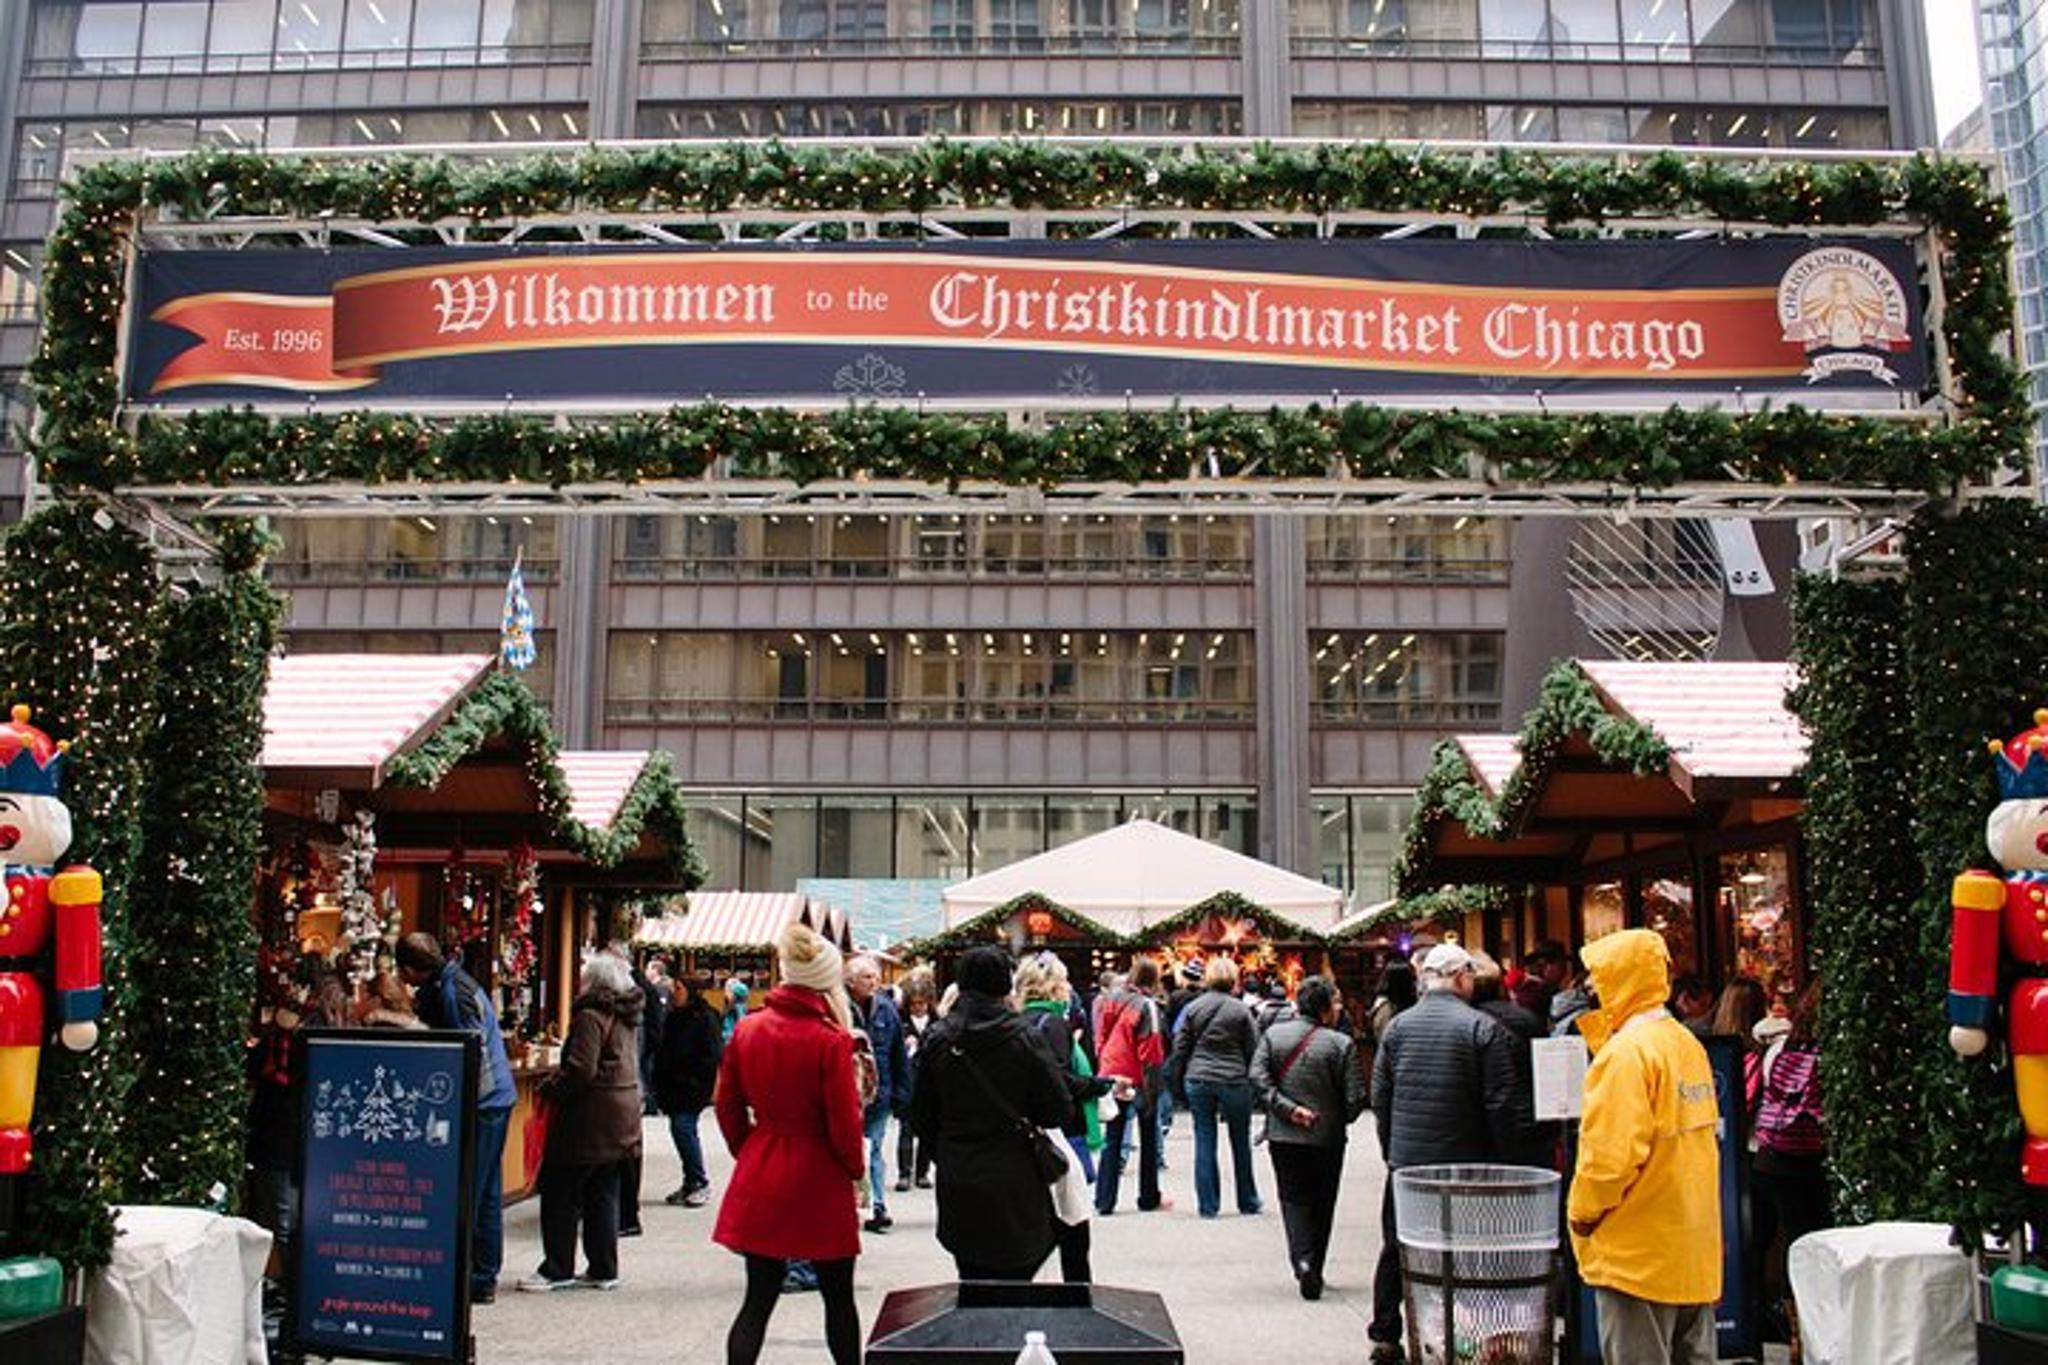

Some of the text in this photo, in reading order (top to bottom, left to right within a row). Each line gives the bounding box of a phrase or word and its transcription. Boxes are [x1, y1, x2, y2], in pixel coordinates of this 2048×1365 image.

[223, 329, 323, 352] Est. 1996
[431, 271, 1705, 368] Wilkommen to the Christkindlmarket Chicago
